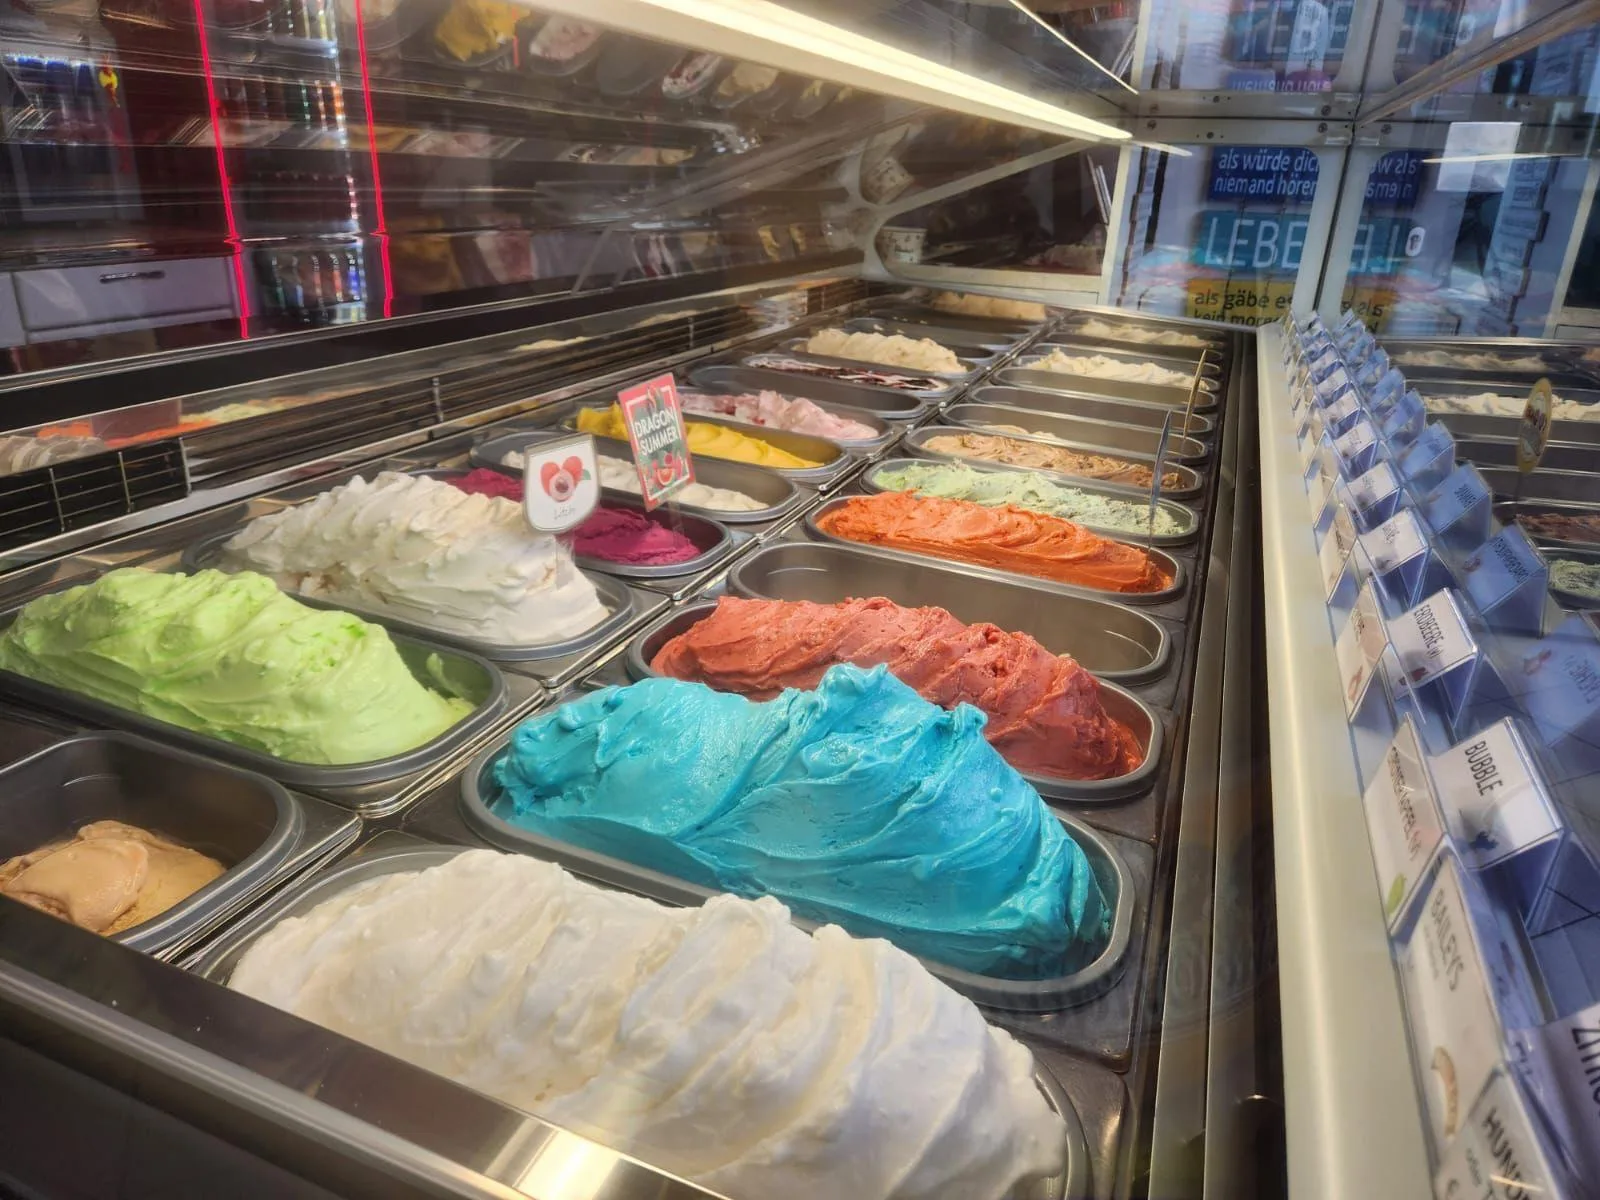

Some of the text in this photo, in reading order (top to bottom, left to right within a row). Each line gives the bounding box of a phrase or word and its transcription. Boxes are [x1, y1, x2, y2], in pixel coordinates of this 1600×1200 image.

[1218, 148, 1240, 170] als
[1242, 148, 1291, 172] würde
[1214, 173, 1277, 194] niemand
[1195, 288, 1219, 306] als
[1223, 289, 1270, 311] gäbe
[634, 407, 676, 438] DRAGON
[640, 426, 679, 457] SUMMER
[1414, 604, 1444, 648] ERDBEERE
[1464, 740, 1503, 796] BUBBLE
[1431, 887, 1464, 992] BAILEYS
